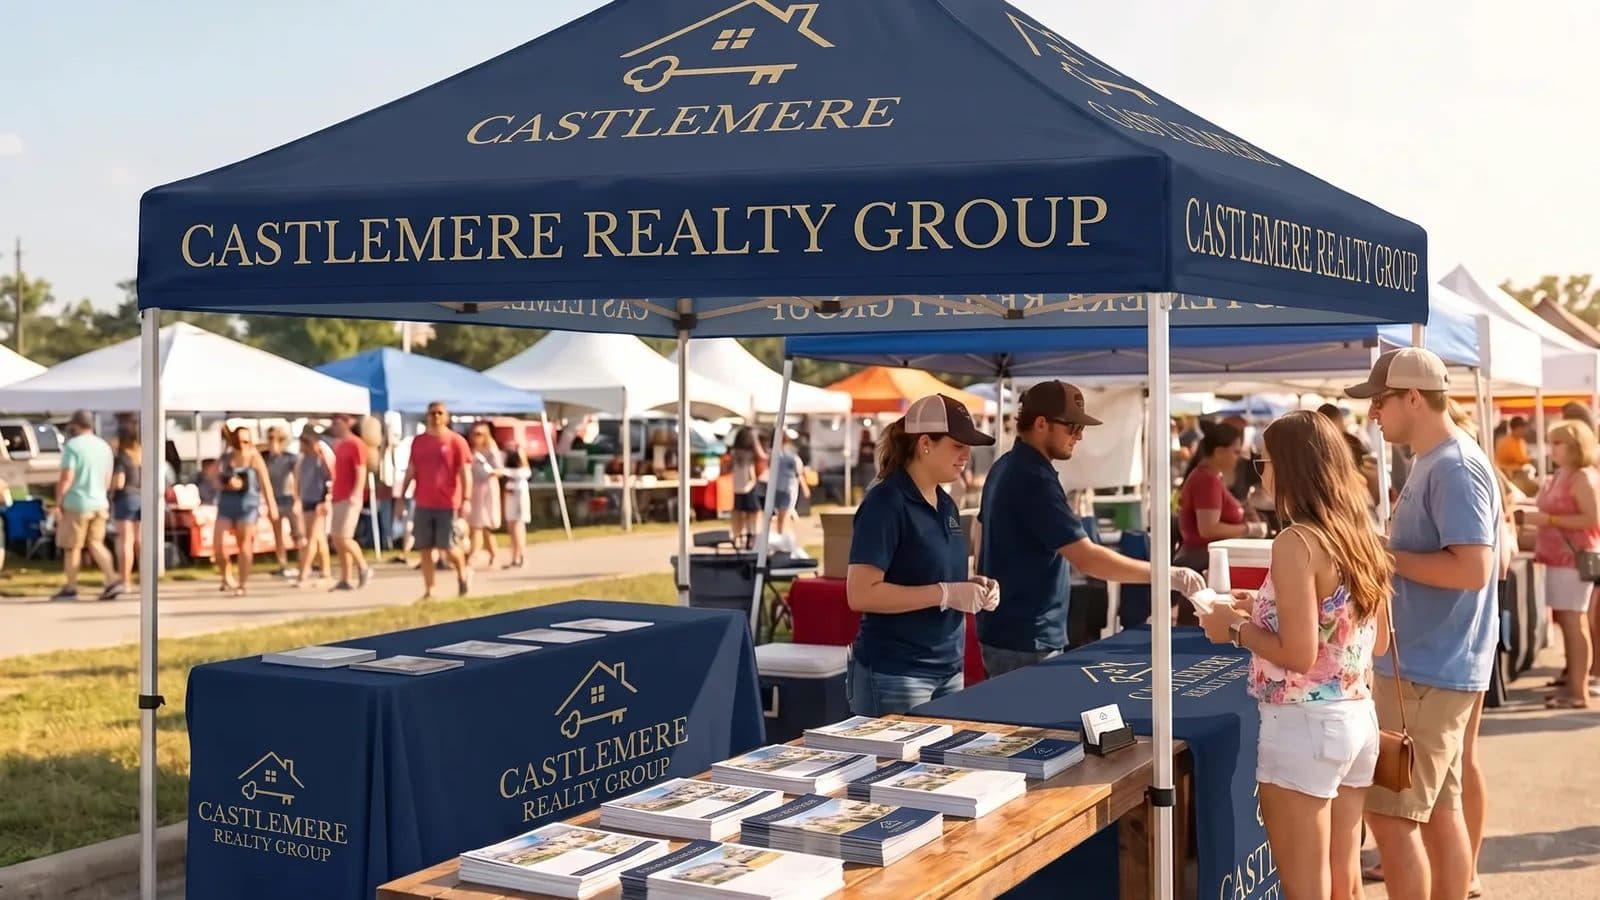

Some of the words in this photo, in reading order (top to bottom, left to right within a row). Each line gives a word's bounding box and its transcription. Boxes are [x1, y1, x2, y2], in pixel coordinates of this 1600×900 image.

[466, 96, 901, 145] CASTLEMERE
[181, 212, 563, 268] CASTLEMERE
[584, 203, 835, 258] REALTY
[854, 195, 1108, 251] GROUP
[1185, 197, 1312, 273] CASTLEMERE
[1316, 229, 1372, 284] REALTY
[1374, 244, 1418, 293] GROUP
[499, 716, 689, 799] CASTLEMERE
[522, 778, 600, 823] REALTY
[605, 756, 671, 794] GROUP
[198, 801, 348, 845] CASTLEMERE
[213, 828, 272, 852] REALTY
[275, 839, 331, 862] GROUP
